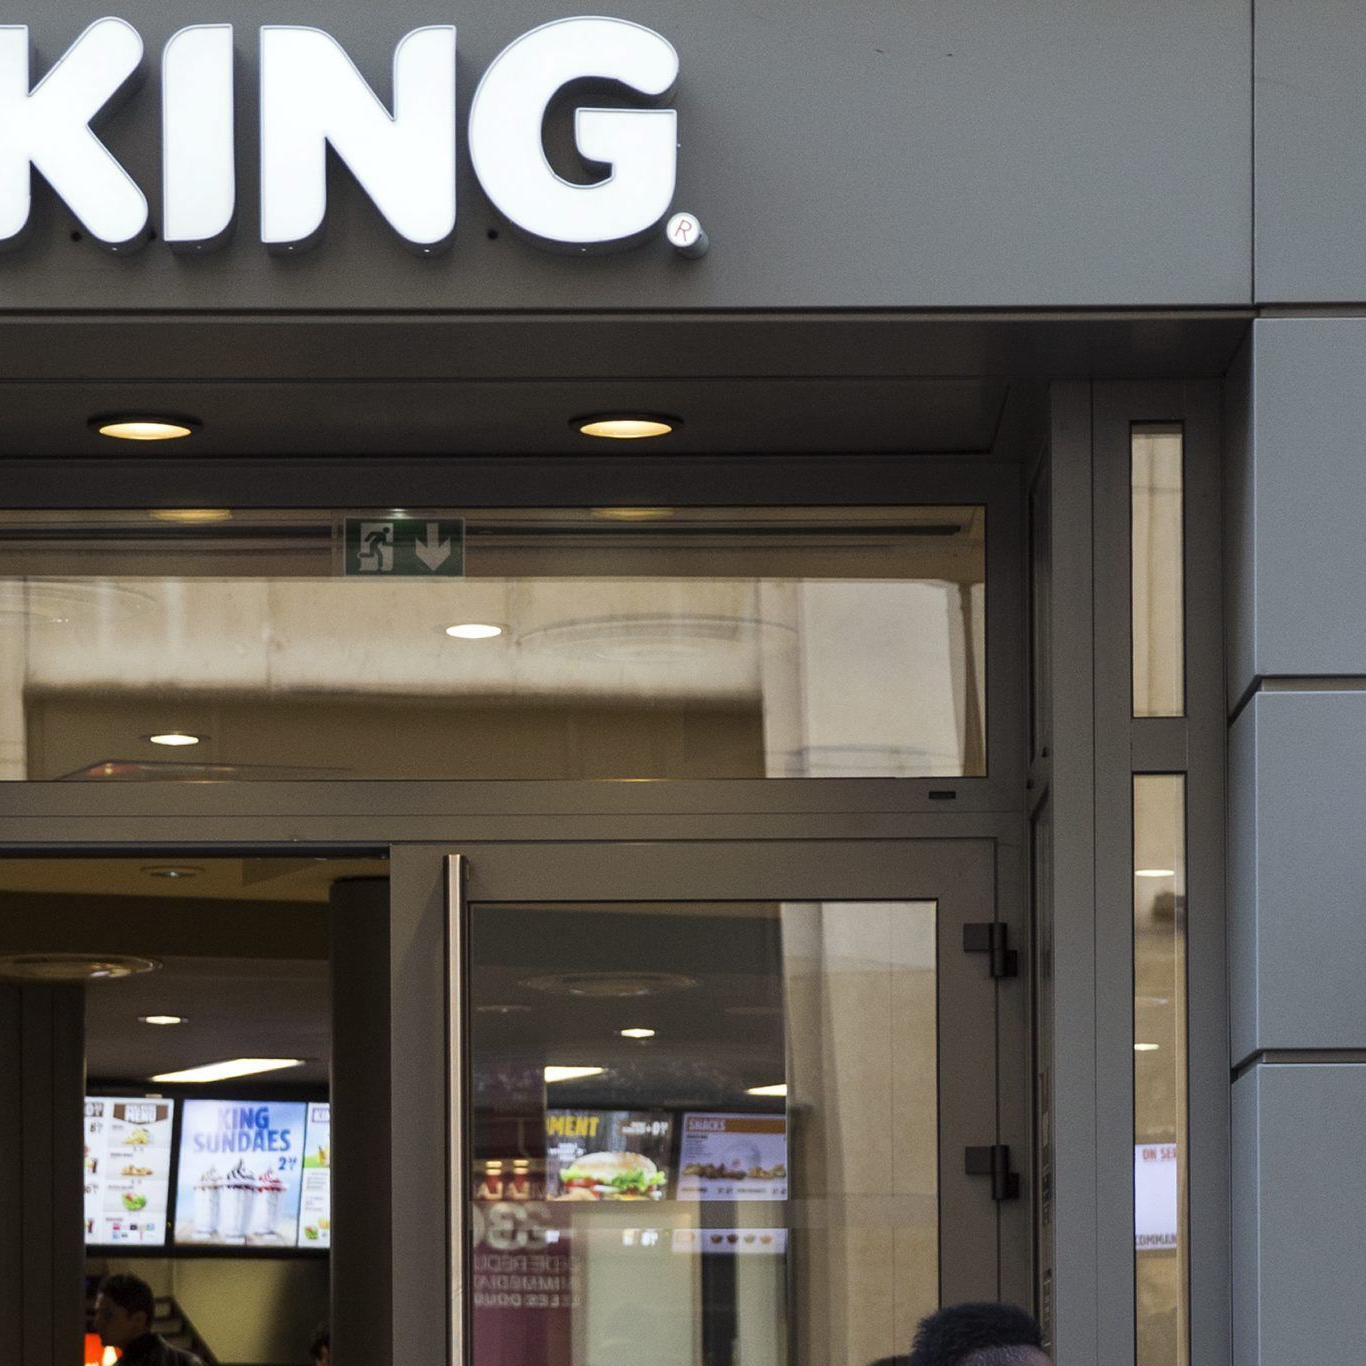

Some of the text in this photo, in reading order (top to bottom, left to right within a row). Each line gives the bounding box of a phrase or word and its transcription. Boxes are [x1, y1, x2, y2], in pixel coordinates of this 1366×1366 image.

[217, 1105, 270, 1131] KING
[688, 1118, 726, 1132] SNACKS
[192, 1129, 292, 1153] SUNDAES
